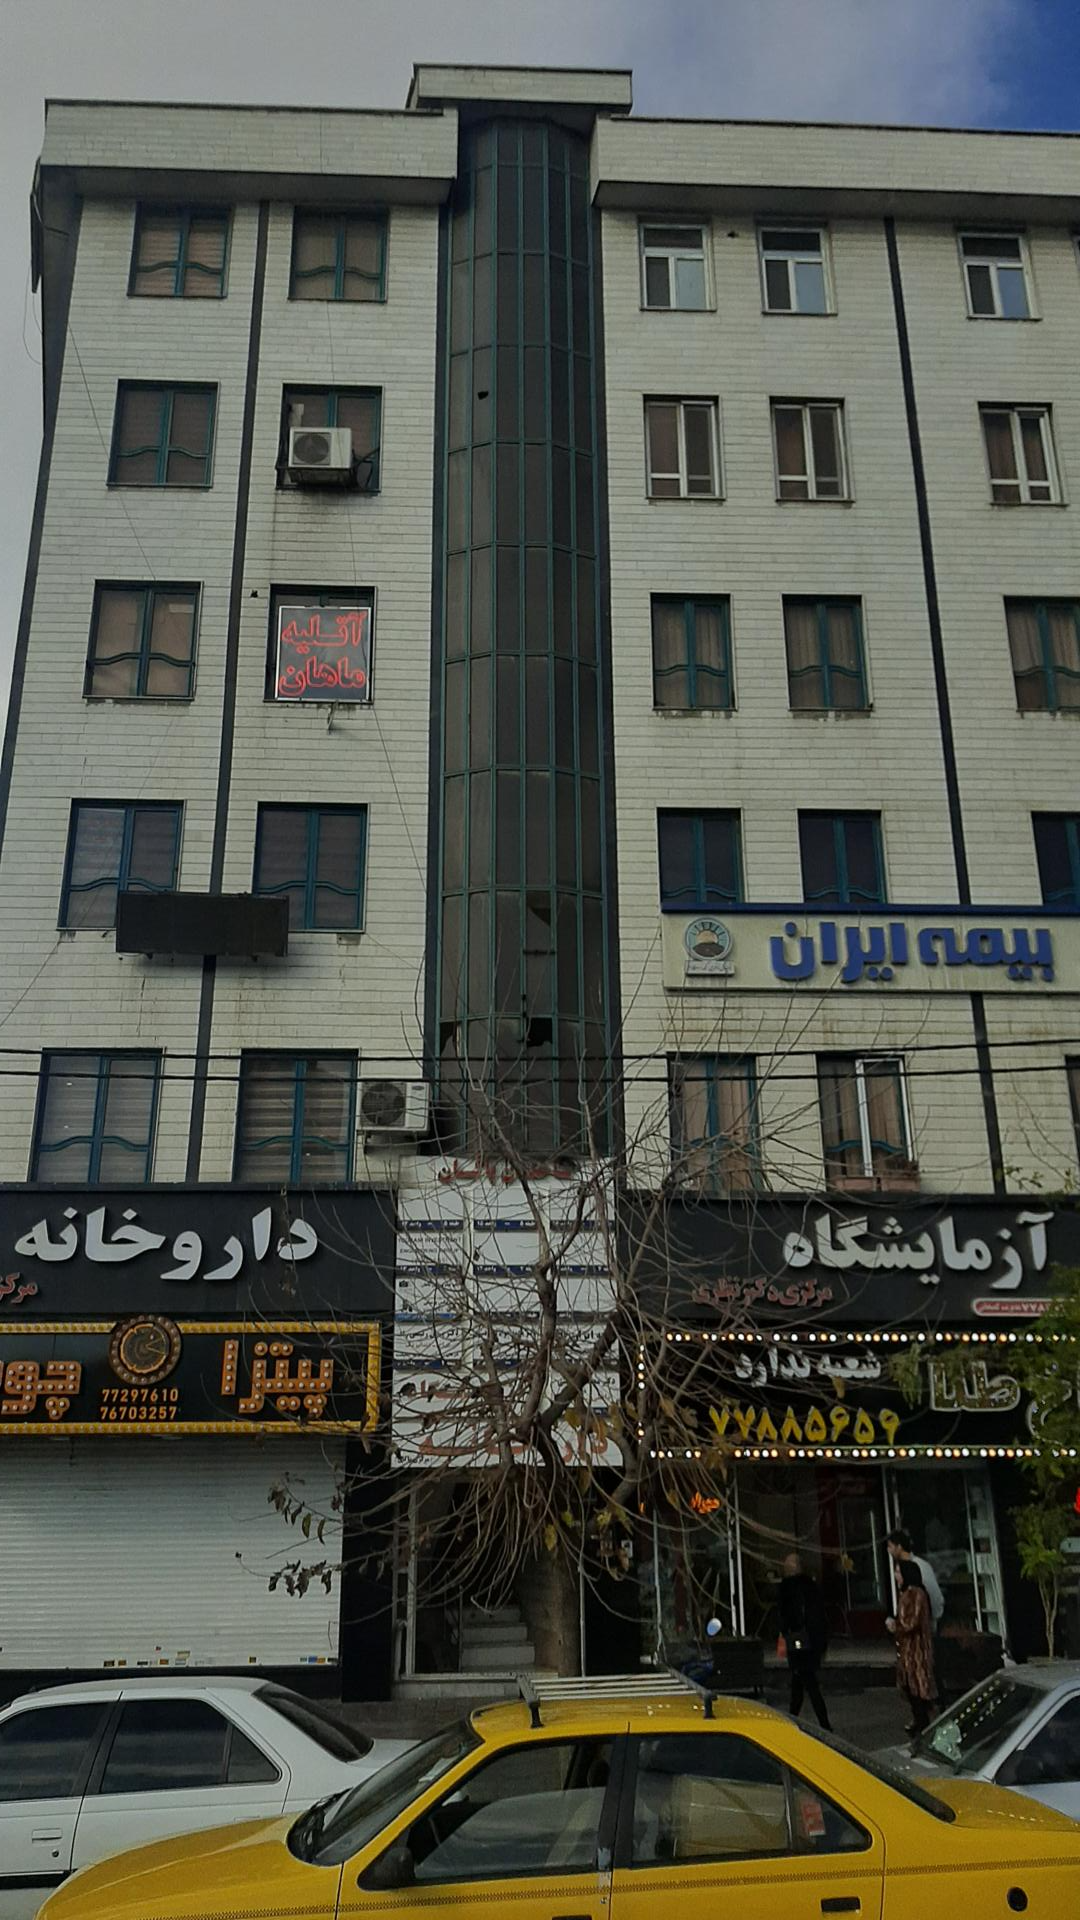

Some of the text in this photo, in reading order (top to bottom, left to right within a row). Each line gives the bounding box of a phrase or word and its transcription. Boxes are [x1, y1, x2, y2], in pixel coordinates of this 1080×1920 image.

[282, 612, 368, 654] آتلیه
[278, 656, 366, 697] ماهان
[770, 922, 1055, 983] بیمه ایران
[15, 1206, 319, 1281] داروخانه
[783, 1211, 1055, 1290] آزمایشگاه
[0, 1271, 39, 1305] مرک
[221, 1338, 335, 1418] پیتزا
[735, 1346, 882, 1388] شعبه ندارد
[99, 1405, 178, 1421] 76703257
[101, 1387, 180, 1404] 77297610
[708, 1404, 900, 1446] ۷۷۸۸۵۶۵۶
